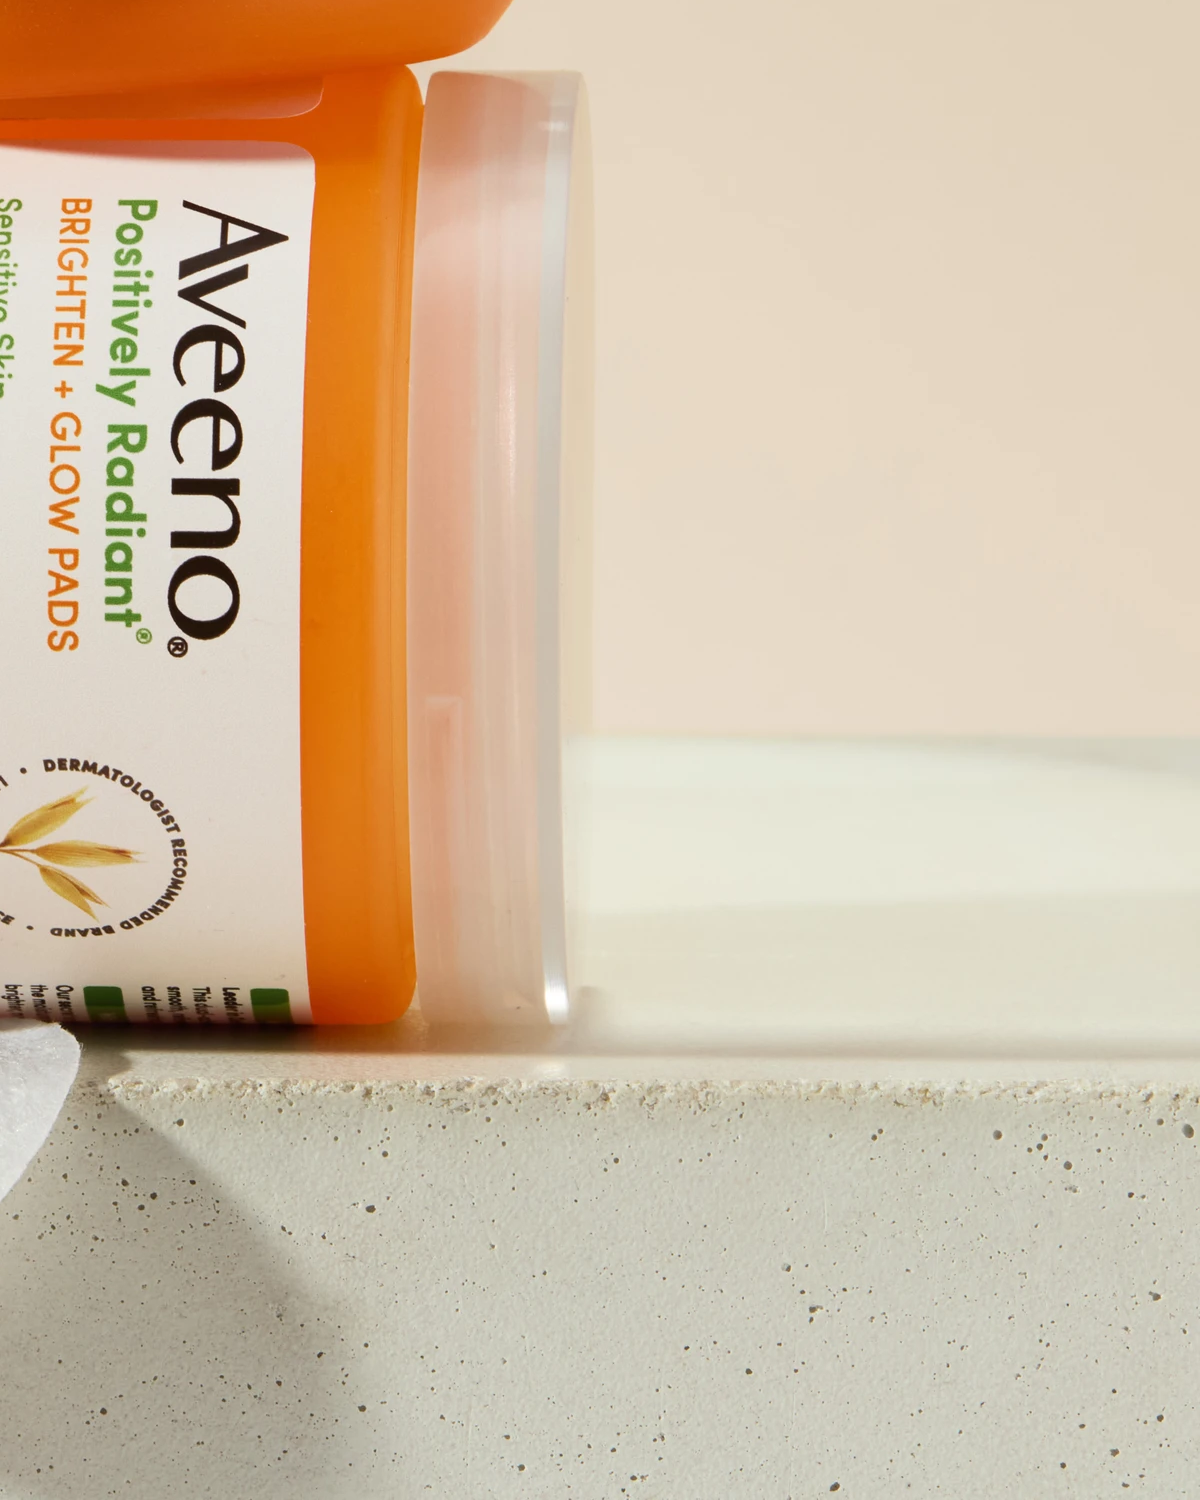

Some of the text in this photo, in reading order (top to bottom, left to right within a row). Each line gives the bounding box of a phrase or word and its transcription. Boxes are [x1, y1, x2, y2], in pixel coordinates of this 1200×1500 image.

[96, 199, 158, 407] Positively
[47, 198, 93, 652] BRIGHTEN + GLOW PADS
[43, 758, 188, 937] DERMATOLOGIST RECOMMENDED BRAND
[29, 984, 52, 997] the
[55, 985, 77, 1000] Our
[141, 986, 164, 1001] and
[192, 986, 213, 1002] This
